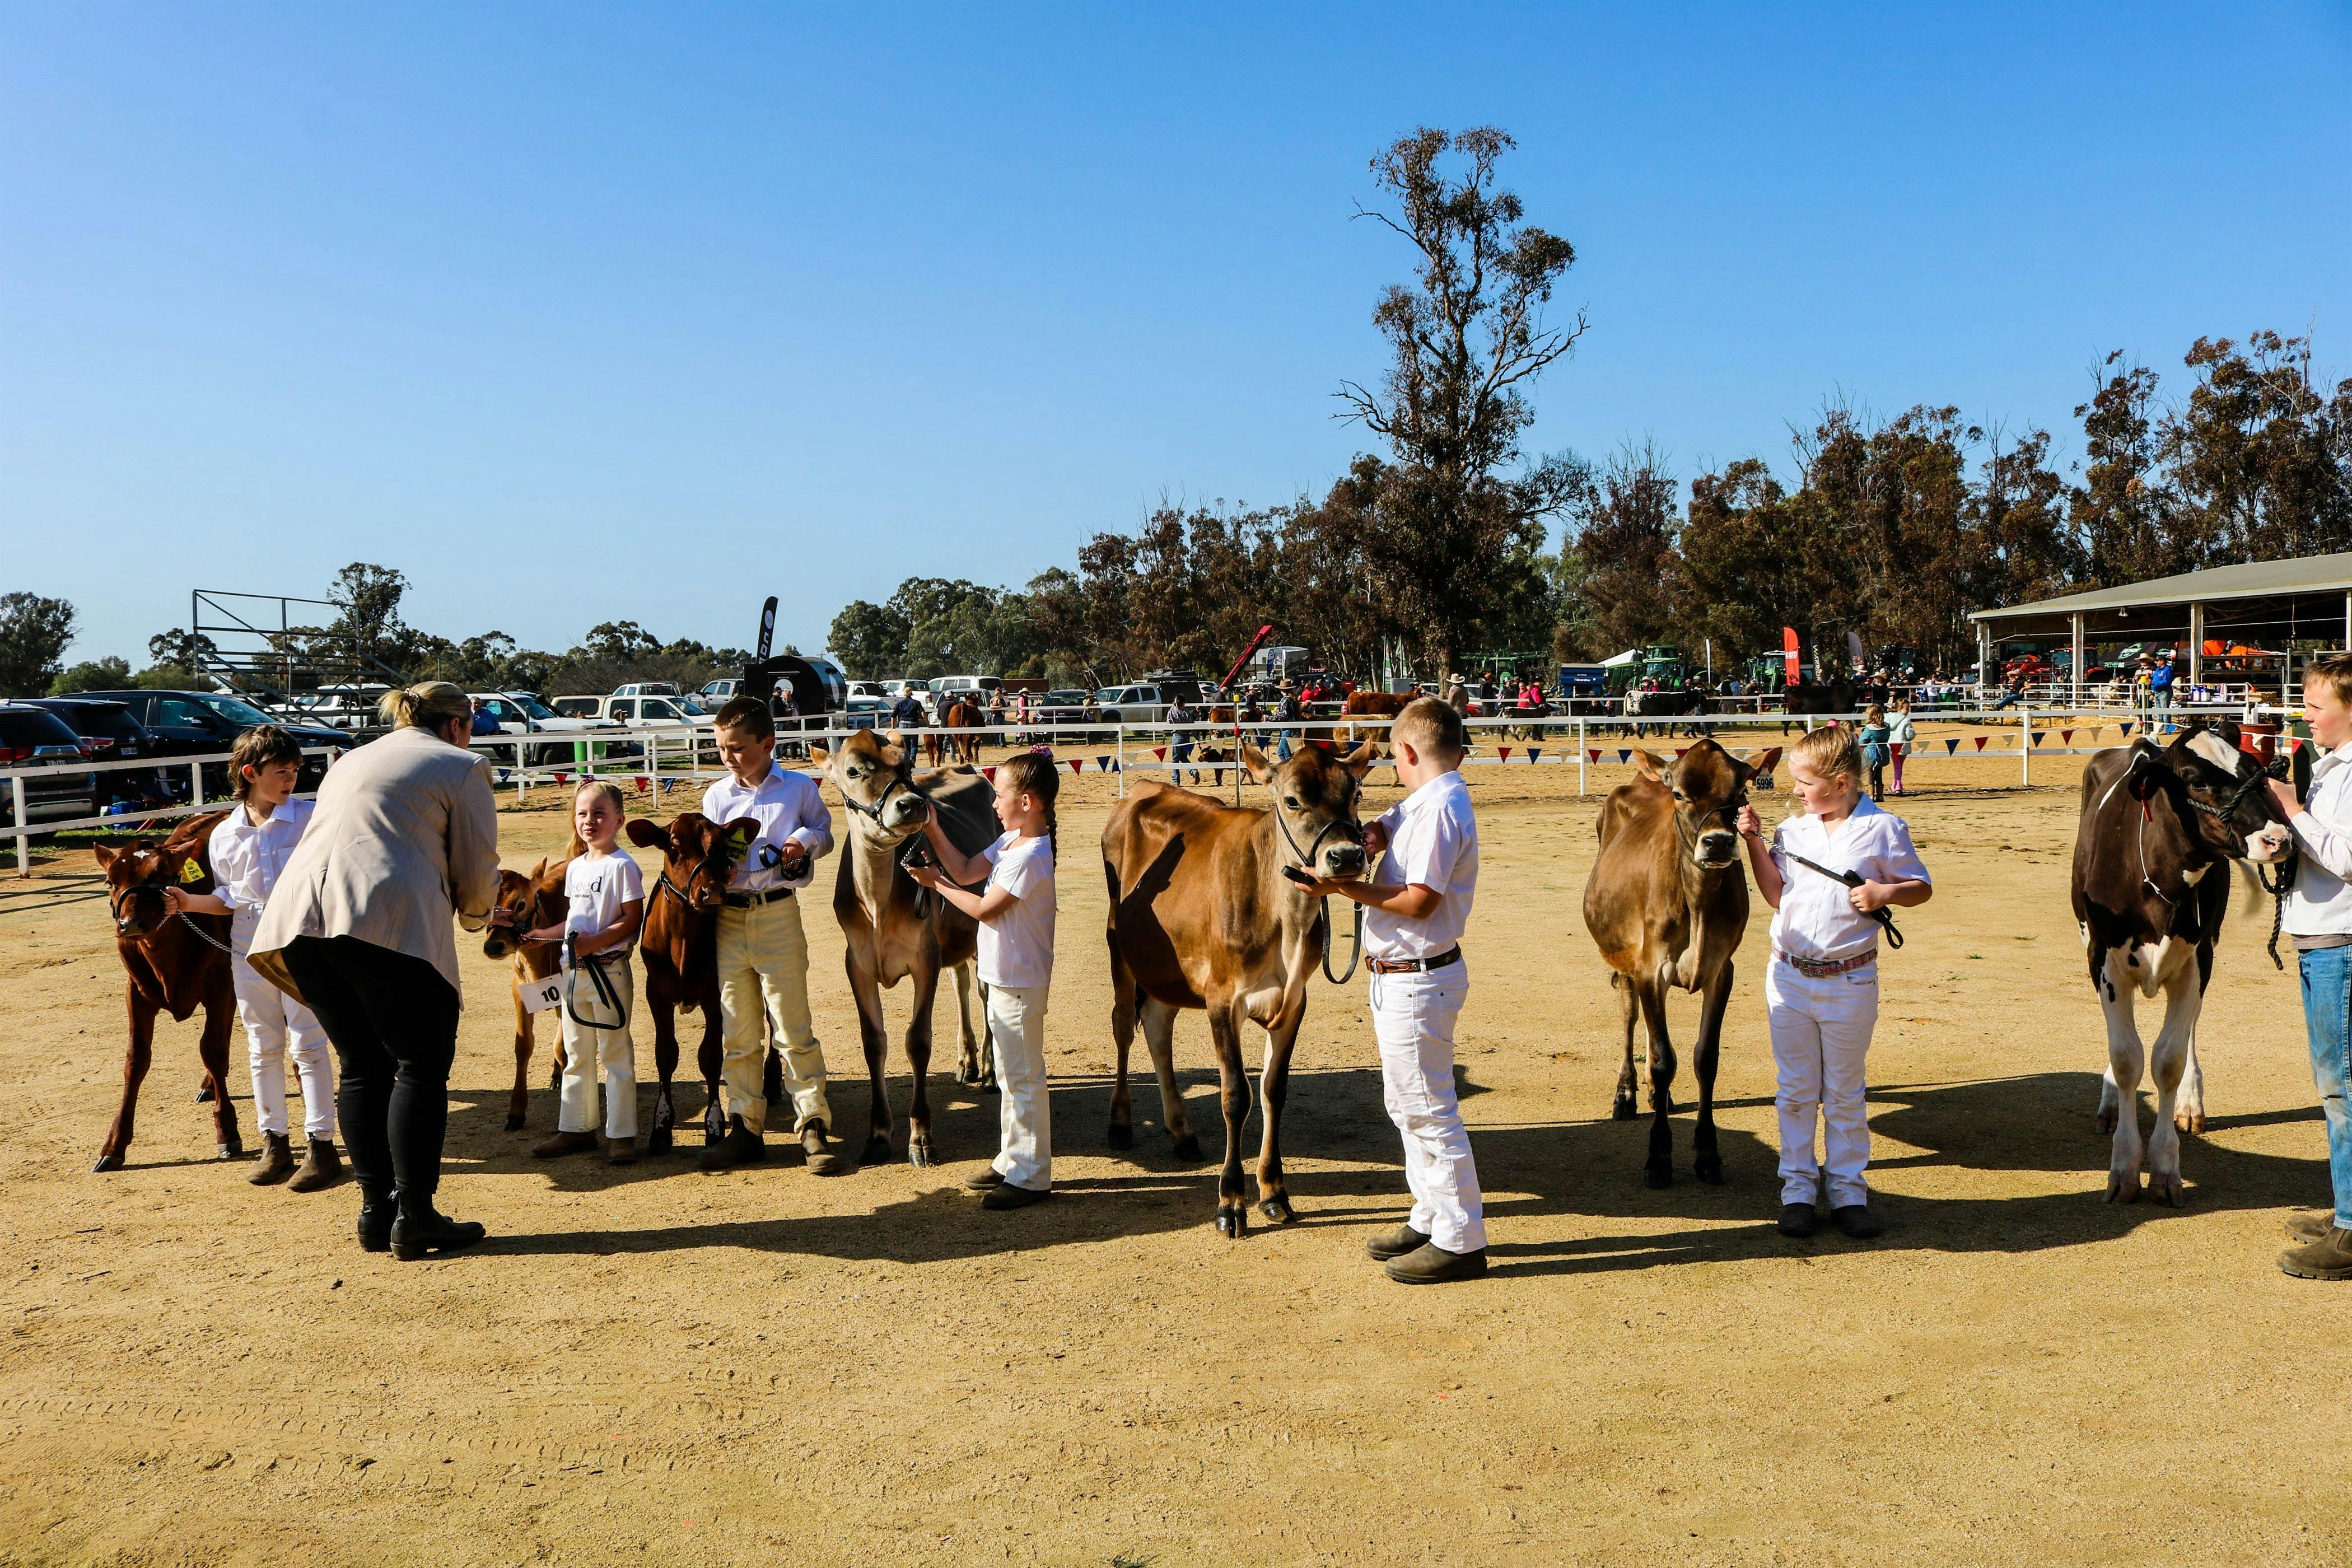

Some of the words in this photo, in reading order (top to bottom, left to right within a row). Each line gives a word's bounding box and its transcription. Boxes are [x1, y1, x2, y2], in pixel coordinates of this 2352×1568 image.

[1812, 645, 1821, 682] WARRIOR
[1757, 778, 1774, 790] 5996
[542, 986, 559, 1002] 10
